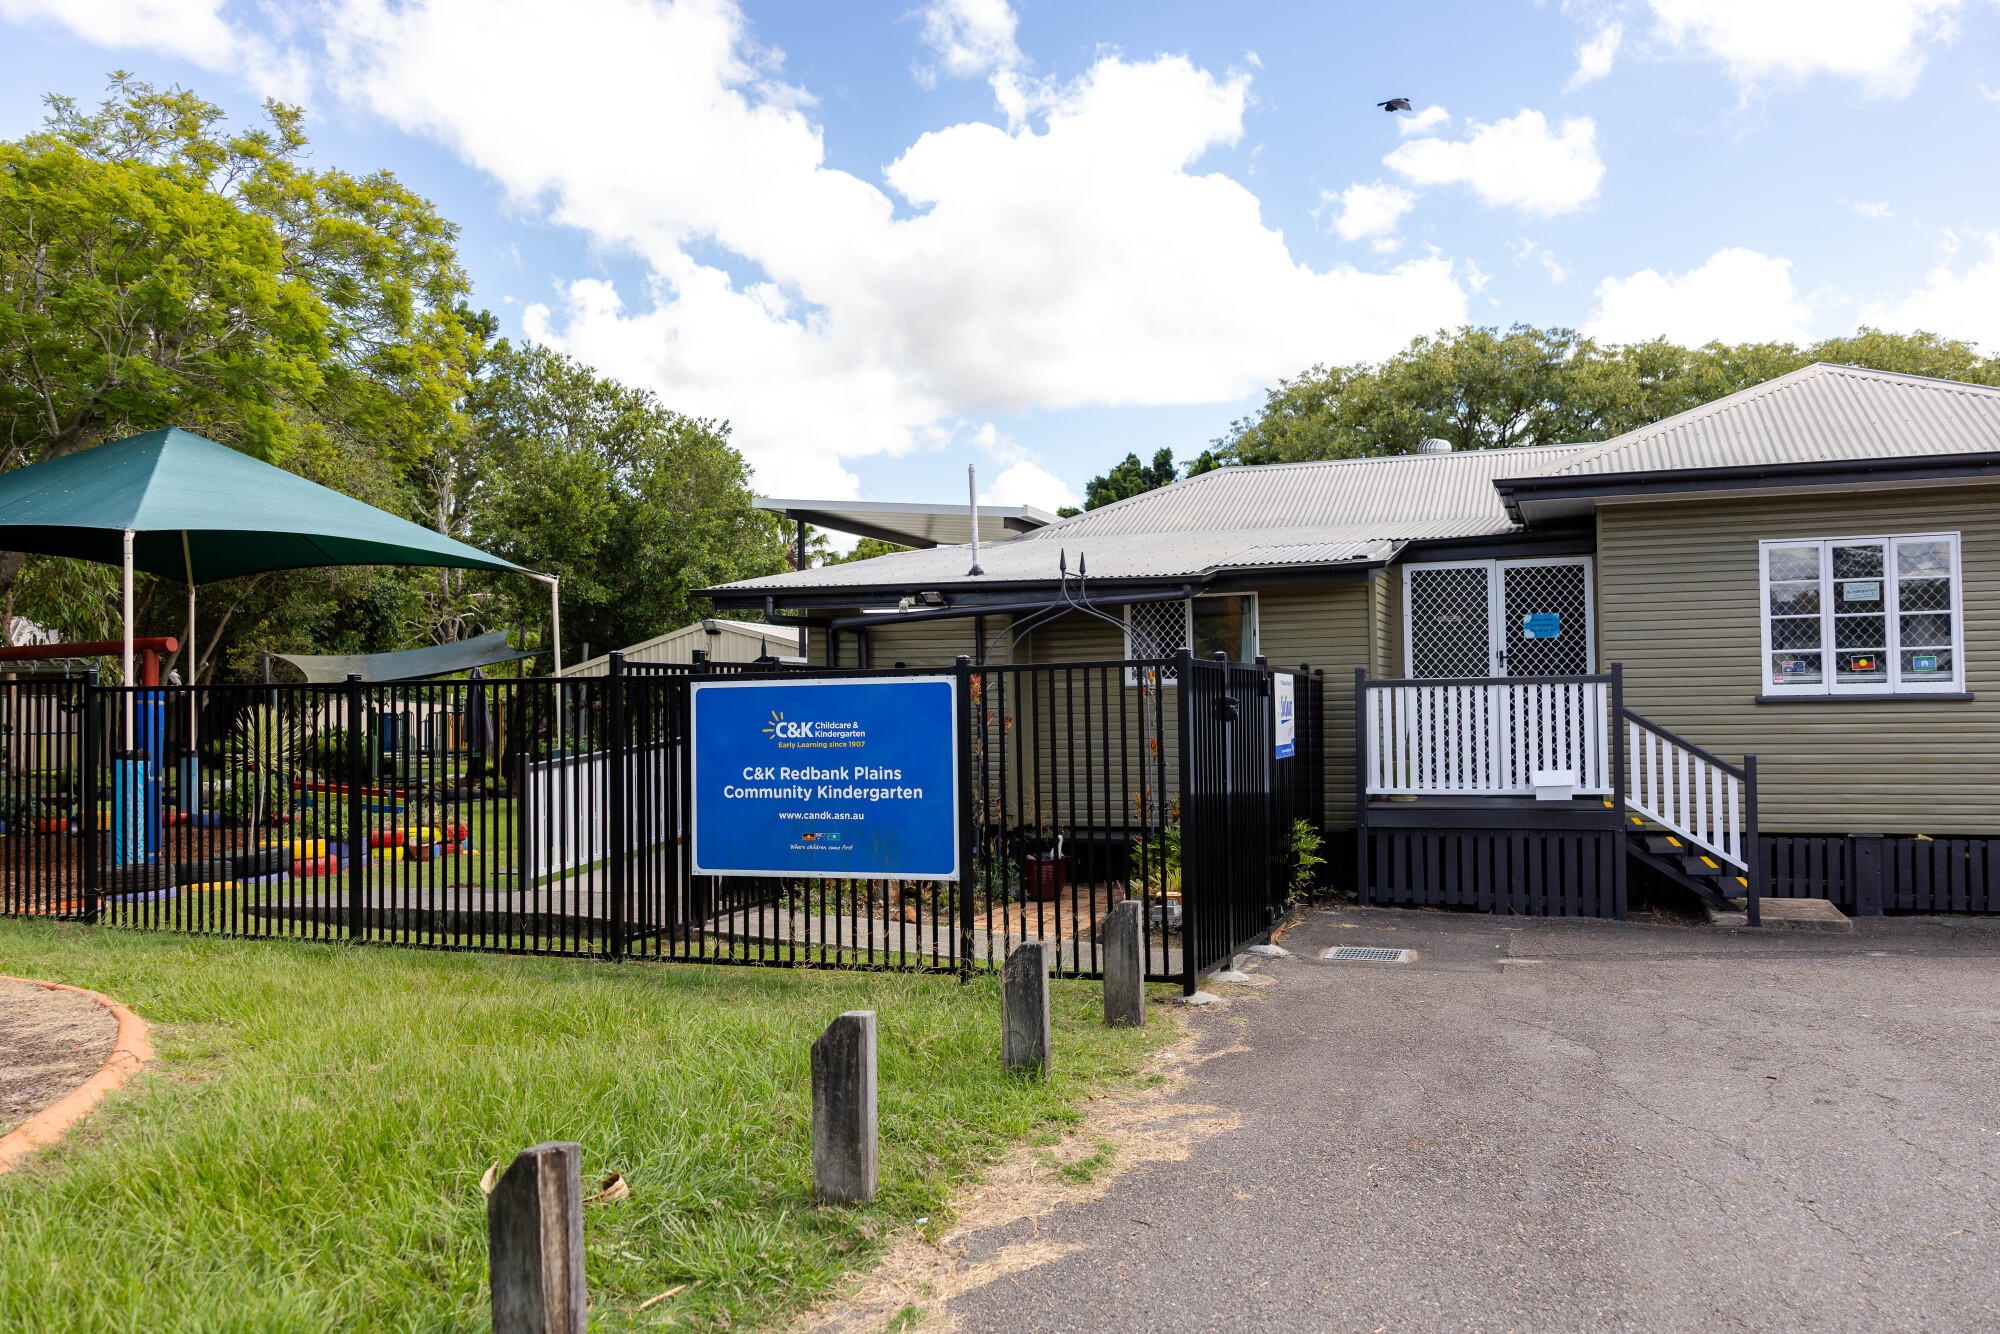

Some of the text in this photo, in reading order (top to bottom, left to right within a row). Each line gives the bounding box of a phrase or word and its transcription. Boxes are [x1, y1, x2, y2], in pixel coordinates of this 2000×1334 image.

[776, 721, 814, 739] C&K
[814, 721, 859, 730] Childcare &
[814, 729, 866, 739] Kindergarten
[797, 741, 828, 749] Learning
[743, 766, 902, 781] C&K Redbank Plains
[723, 785, 923, 802] Community Kindergarten
[778, 811, 865, 821] www.candk.asn.au
